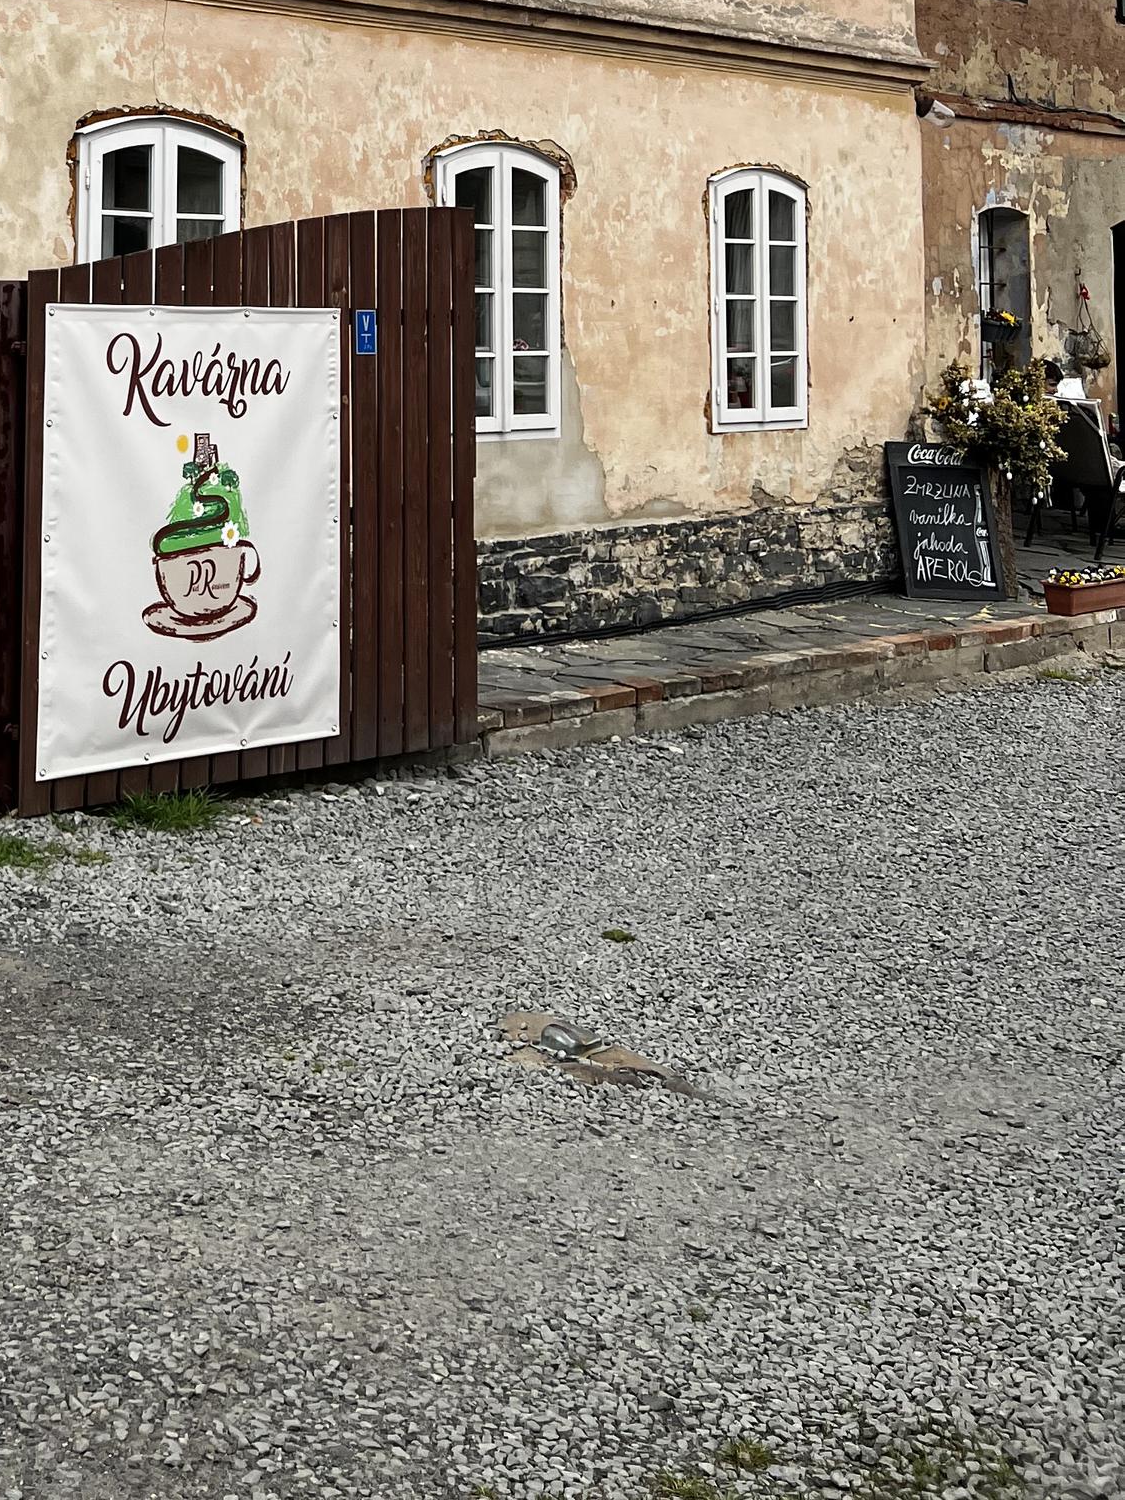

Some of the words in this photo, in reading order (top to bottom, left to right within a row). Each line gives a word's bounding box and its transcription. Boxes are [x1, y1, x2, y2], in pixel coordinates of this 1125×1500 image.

[106, 332, 291, 428] Kavárna
[909, 503, 972, 526] vanilka
[913, 531, 969, 560] jahoda
[917, 554, 982, 587] APEROL
[102, 651, 294, 744] Ubytování
